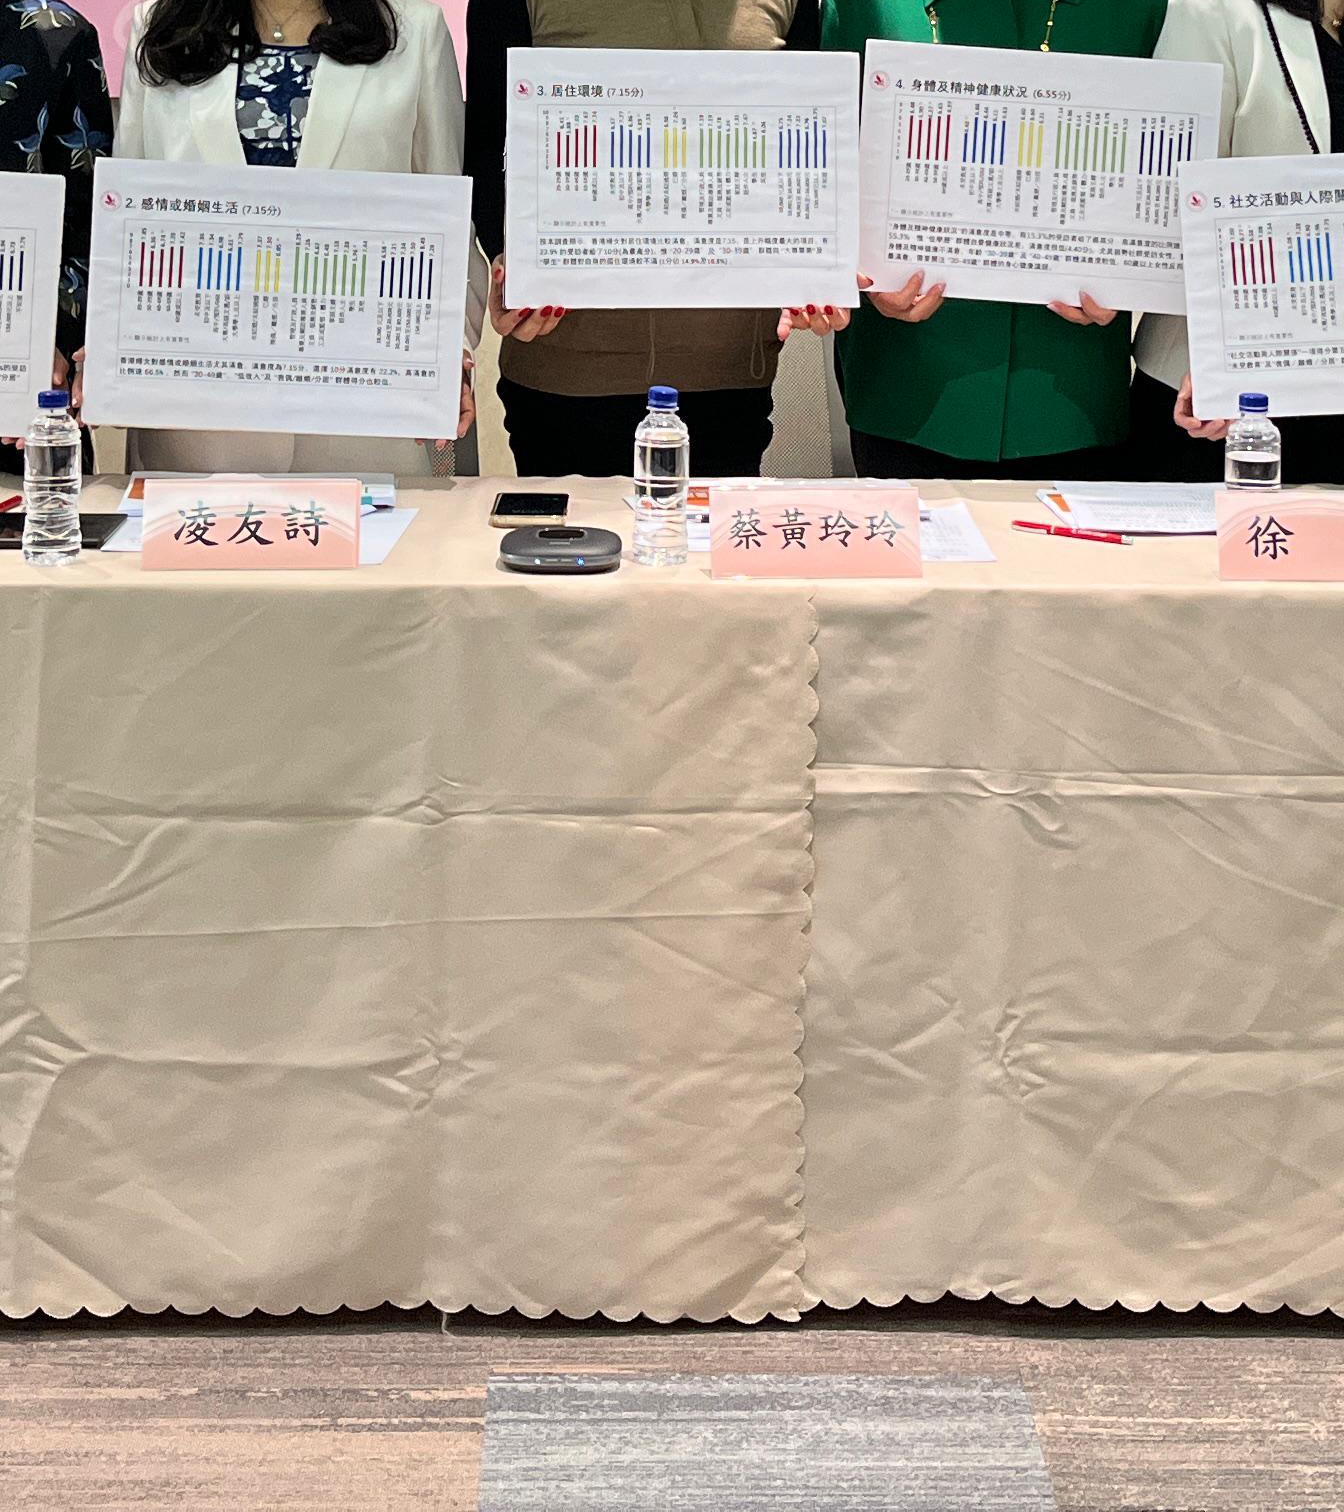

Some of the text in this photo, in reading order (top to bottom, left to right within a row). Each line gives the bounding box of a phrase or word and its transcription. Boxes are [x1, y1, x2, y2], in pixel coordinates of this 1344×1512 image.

[551, 84, 604, 98] 居住環境
[911, 79, 1028, 98] 身體及精神健康狀況
[141, 197, 238, 215] 感情或婚姻生活
[242, 205, 282, 217] (7.15分)
[173, 500, 329, 548] 凌友詩
[728, 507, 904, 550] 蔡黃玲玲
